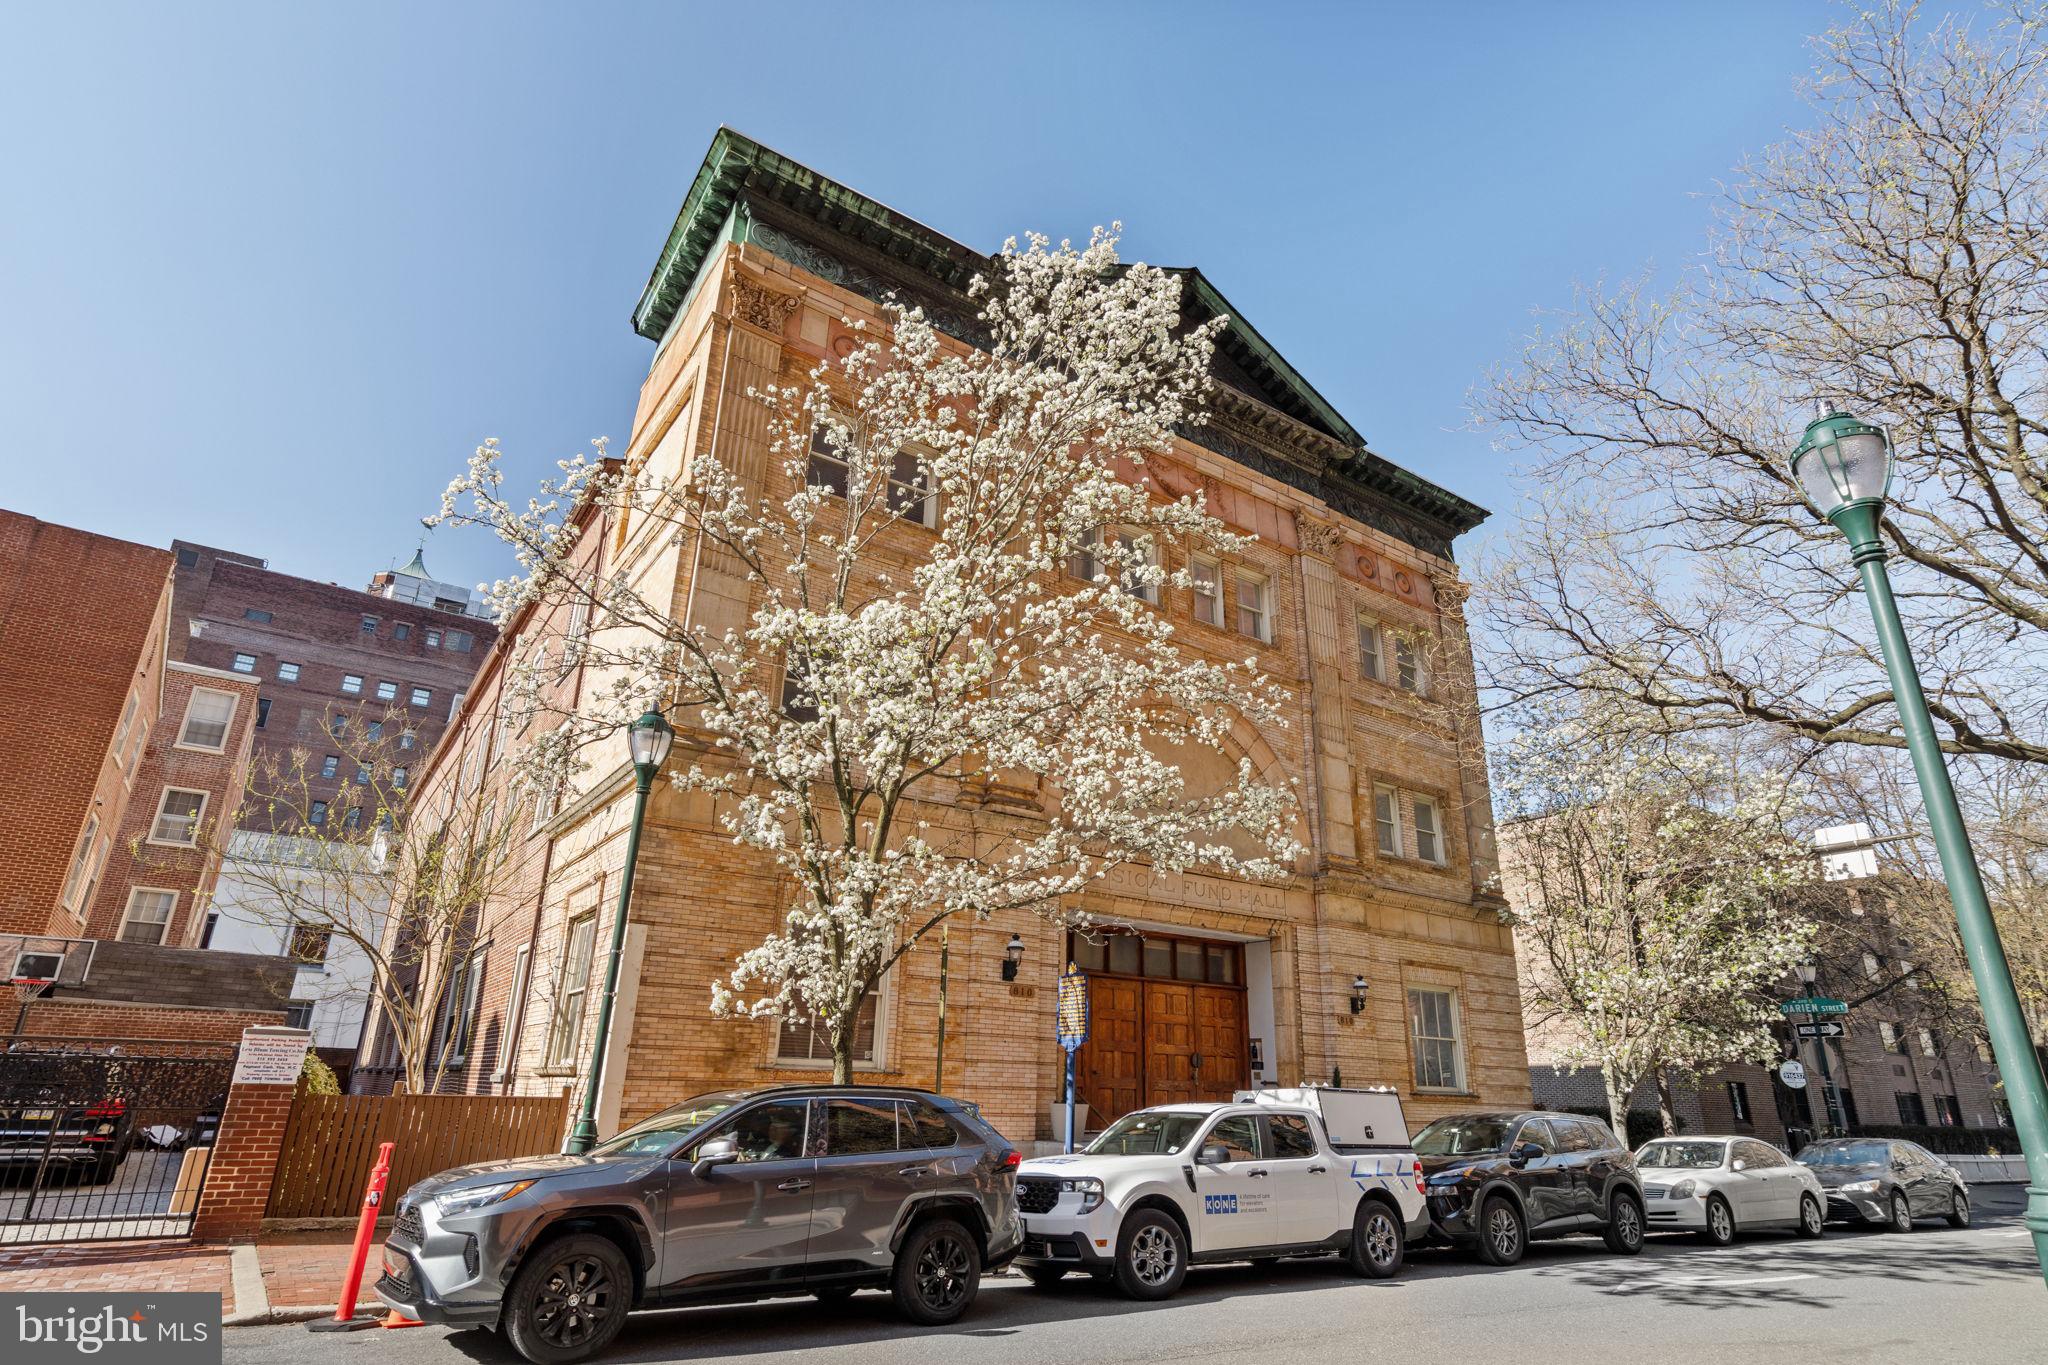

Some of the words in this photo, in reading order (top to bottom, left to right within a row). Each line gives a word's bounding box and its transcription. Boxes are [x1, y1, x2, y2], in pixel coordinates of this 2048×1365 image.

[1096, 865, 1175, 893] SICAL
[1183, 881, 1231, 900] FUND
[1240, 889, 1285, 909] HALL
[1782, 1004, 1819, 1013] DARIEN
[1206, 1198, 1237, 1211] KONE
